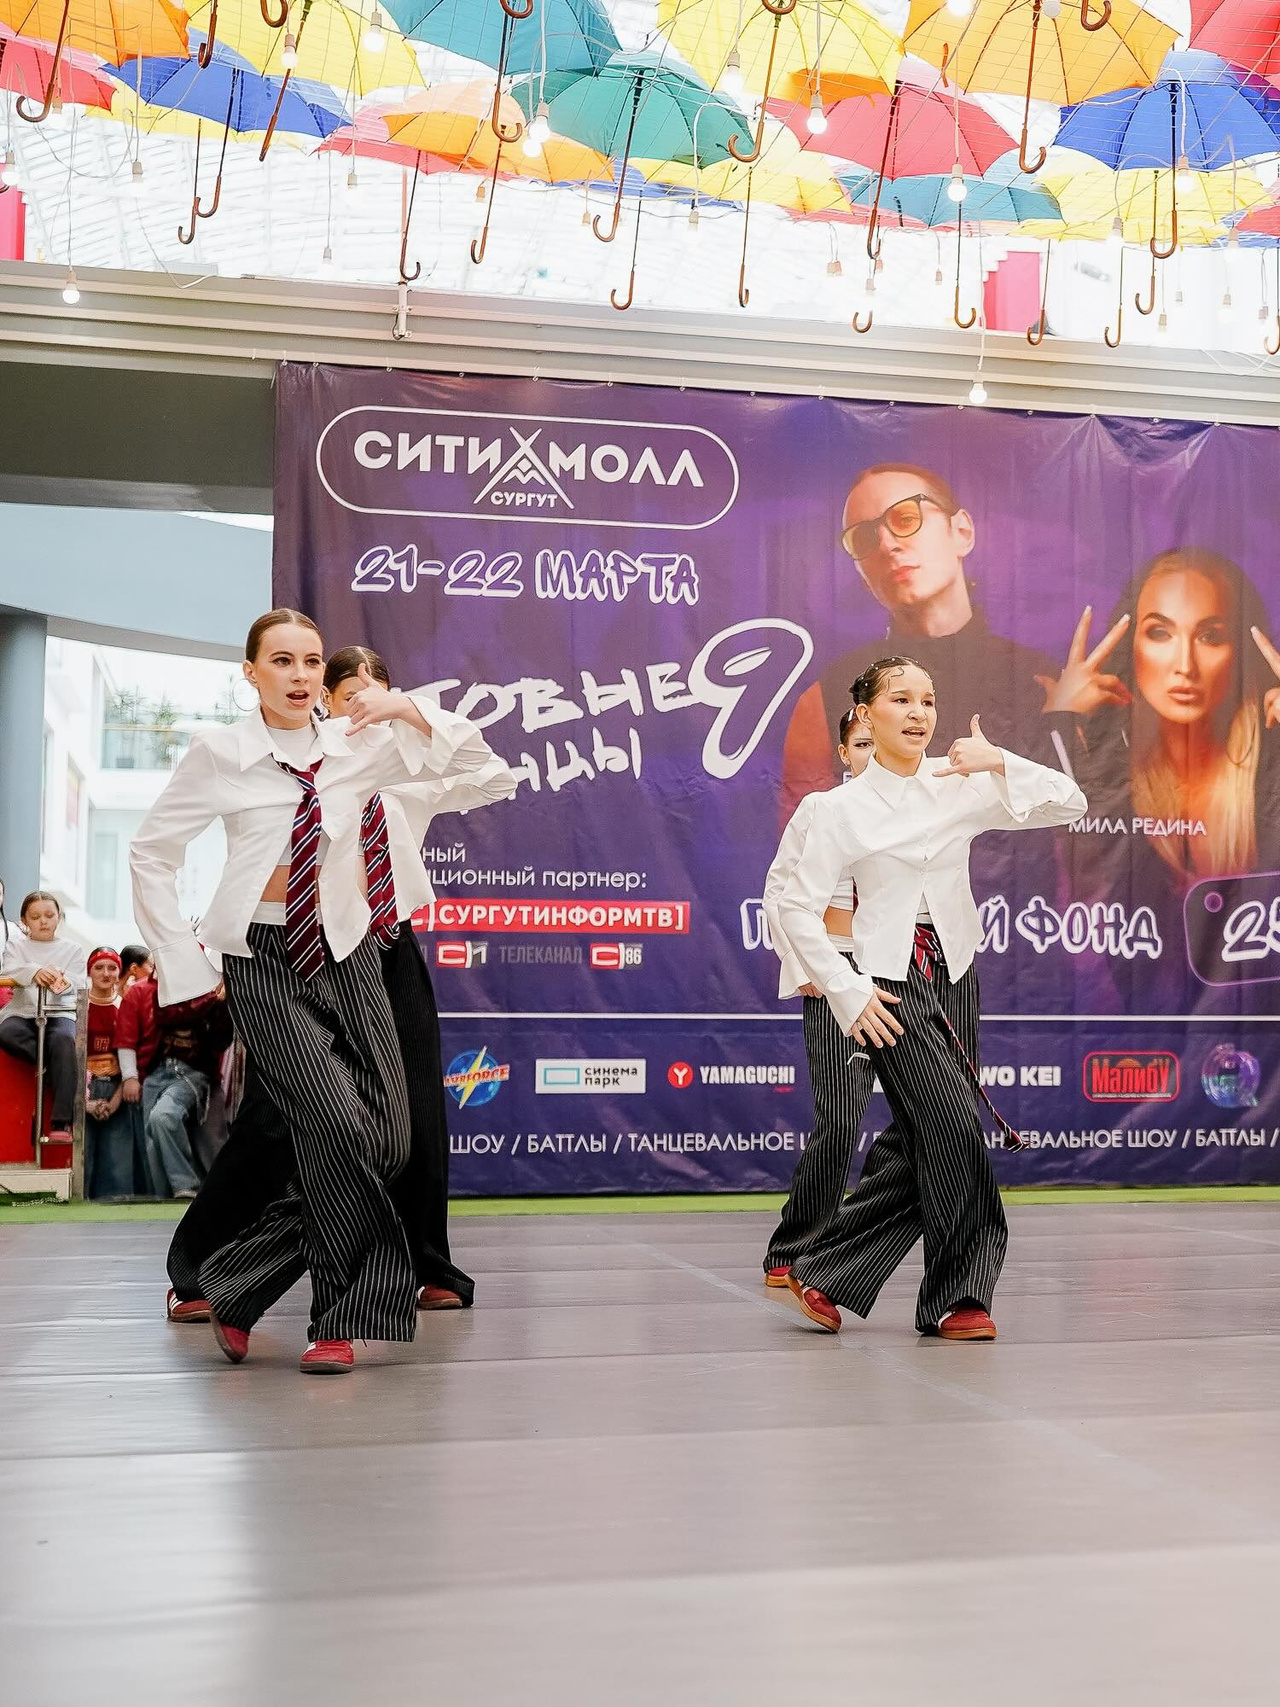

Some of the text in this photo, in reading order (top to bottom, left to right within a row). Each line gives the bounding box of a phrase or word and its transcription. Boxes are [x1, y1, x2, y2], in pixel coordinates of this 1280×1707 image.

[353, 430, 705, 488] СИТИ МОЛЛ
[490, 491, 558, 508] СУРГУТ
[351, 544, 699, 606] 21-22 МАРТА
[508, 727, 642, 800] НЦЫ
[1069, 816, 1207, 837] МИЛА РЕДИНА
[543, 871, 647, 892] партнер:
[1015, 895, 1163, 960] ФОНД
[499, 946, 583, 965] ТЕЛЕКАНАЛ
[584, 1066, 638, 1077] синема
[700, 1066, 796, 1085] YAMAGUCHI
[1020, 1066, 1061, 1086] KEI
[584, 1077, 621, 1089] парк
[450, 1134, 506, 1154] ШОУ
[528, 1134, 606, 1154] БАТТЛЫ
[628, 1132, 795, 1154] ТАНЦЕВАЛЬНОЕ
[1127, 1129, 1177, 1149] ШОУ
[1195, 1129, 1265, 1147] БАТТЛЫ
